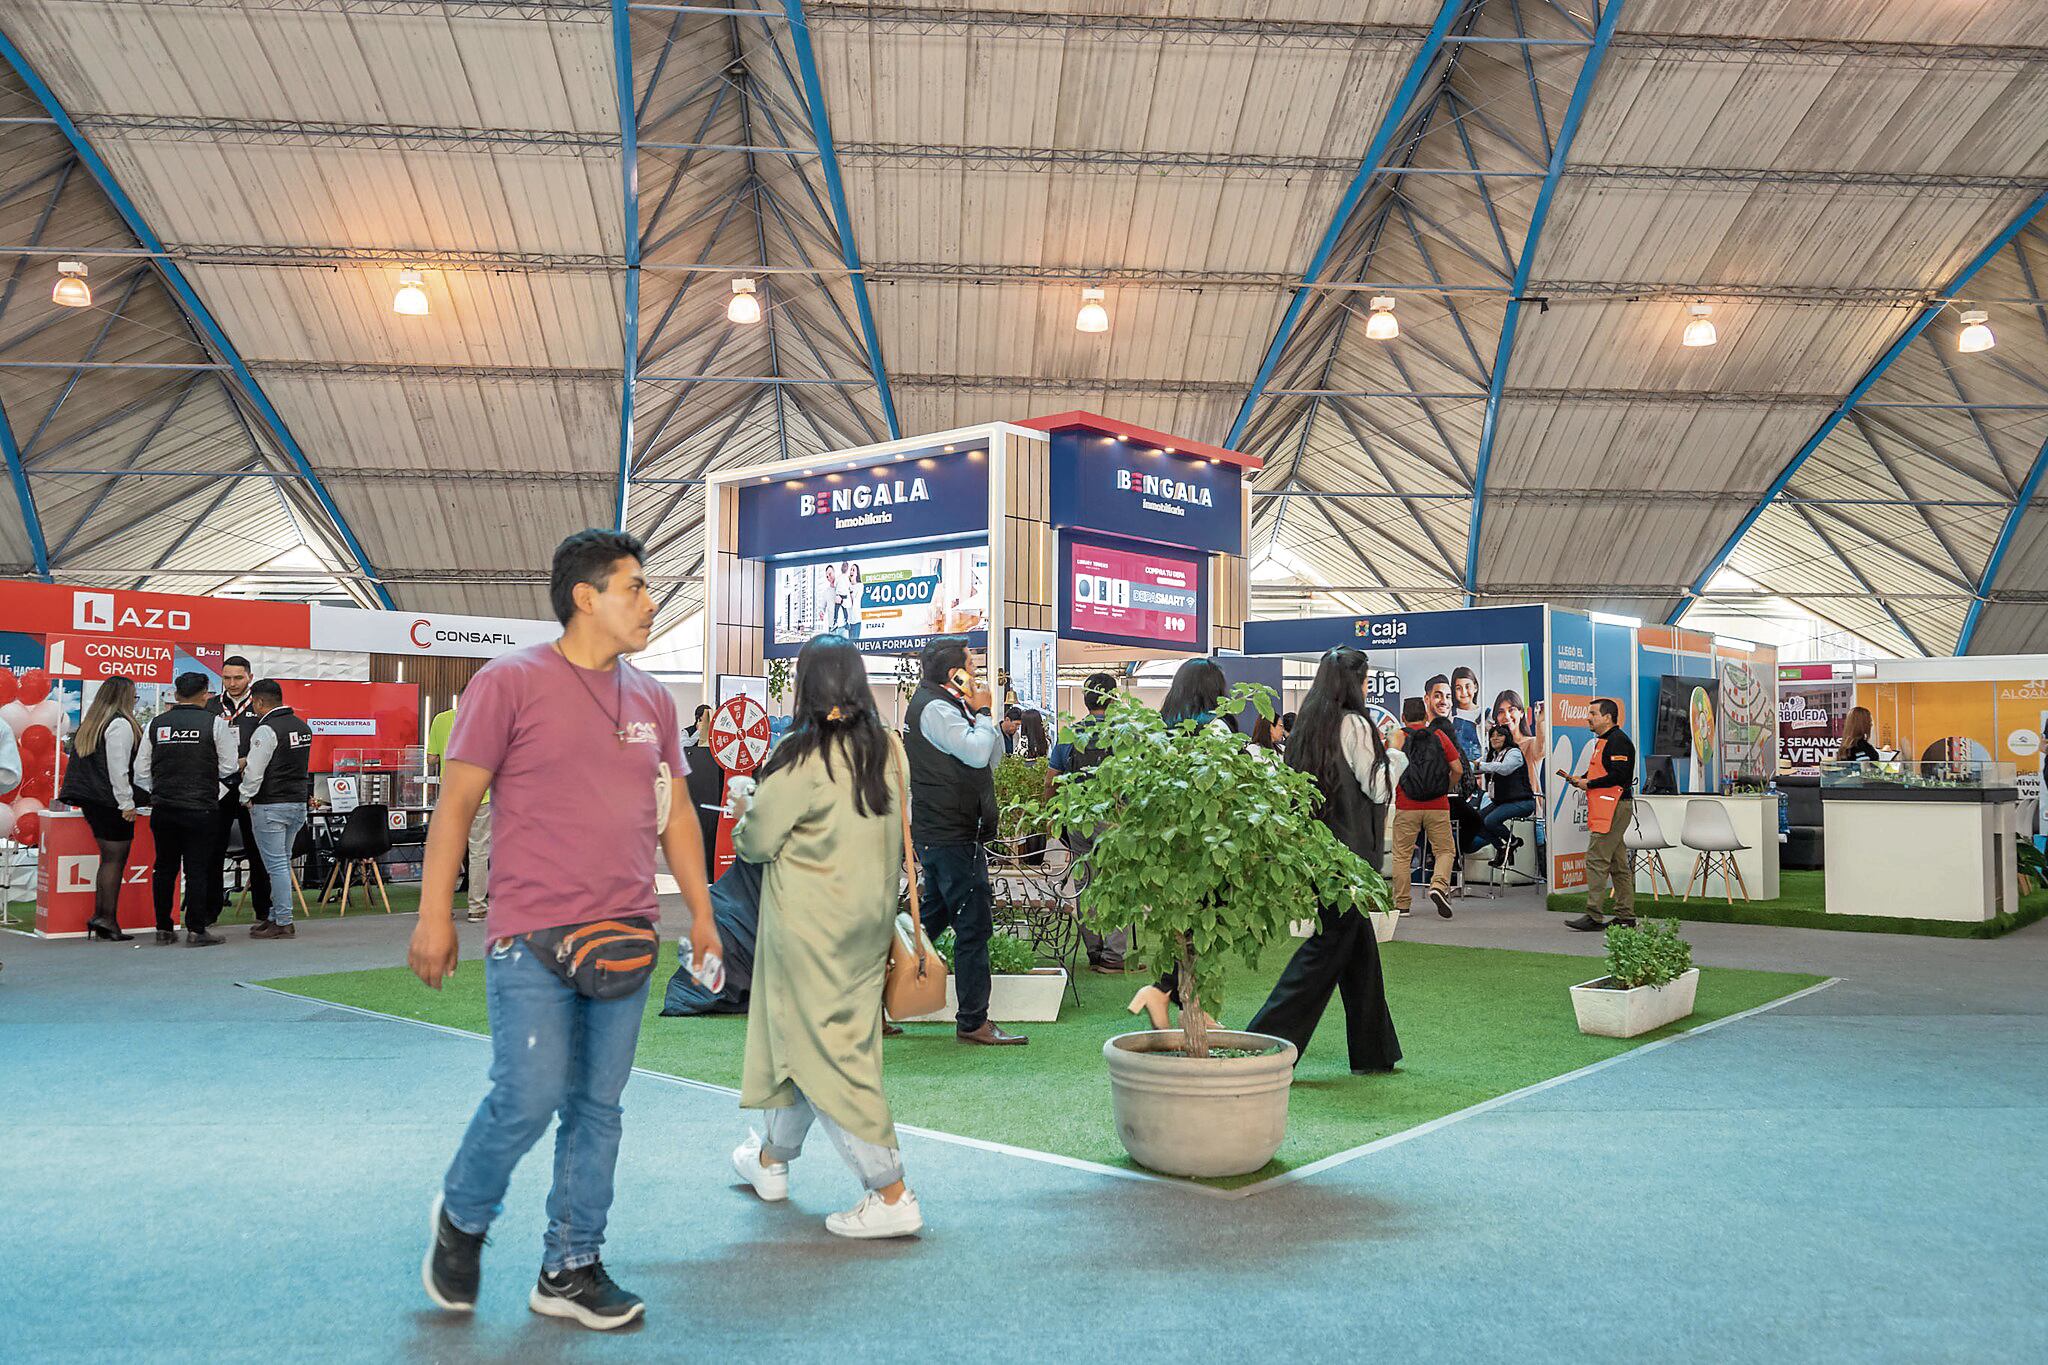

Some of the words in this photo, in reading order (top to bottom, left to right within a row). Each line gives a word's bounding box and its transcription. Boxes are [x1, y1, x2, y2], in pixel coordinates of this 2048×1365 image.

[1117, 469, 1212, 507] BENGALA
[800, 477, 929, 517] BENGALA
[835, 511, 892, 530] inmobiliaria
[1371, 619, 1407, 639] caja
[435, 630, 516, 645] CONSAFIL
[882, 639, 913, 650] FORMA
[914, 638, 926, 647] DE
[85, 643, 171, 661] CONSULTA
[99, 662, 157, 676] GRATIS
[1558, 659, 1586, 672] MOMENTO
[1586, 663, 1595, 673] DE
[1367, 670, 1400, 696] aja
[1558, 674, 1588, 686] DISFRUTAR
[1779, 710, 1827, 721] RBOLEDA
[1787, 737, 1843, 747] SEMANAS
[1573, 809, 1581, 824] La
[1563, 861, 1575, 872] UNA
